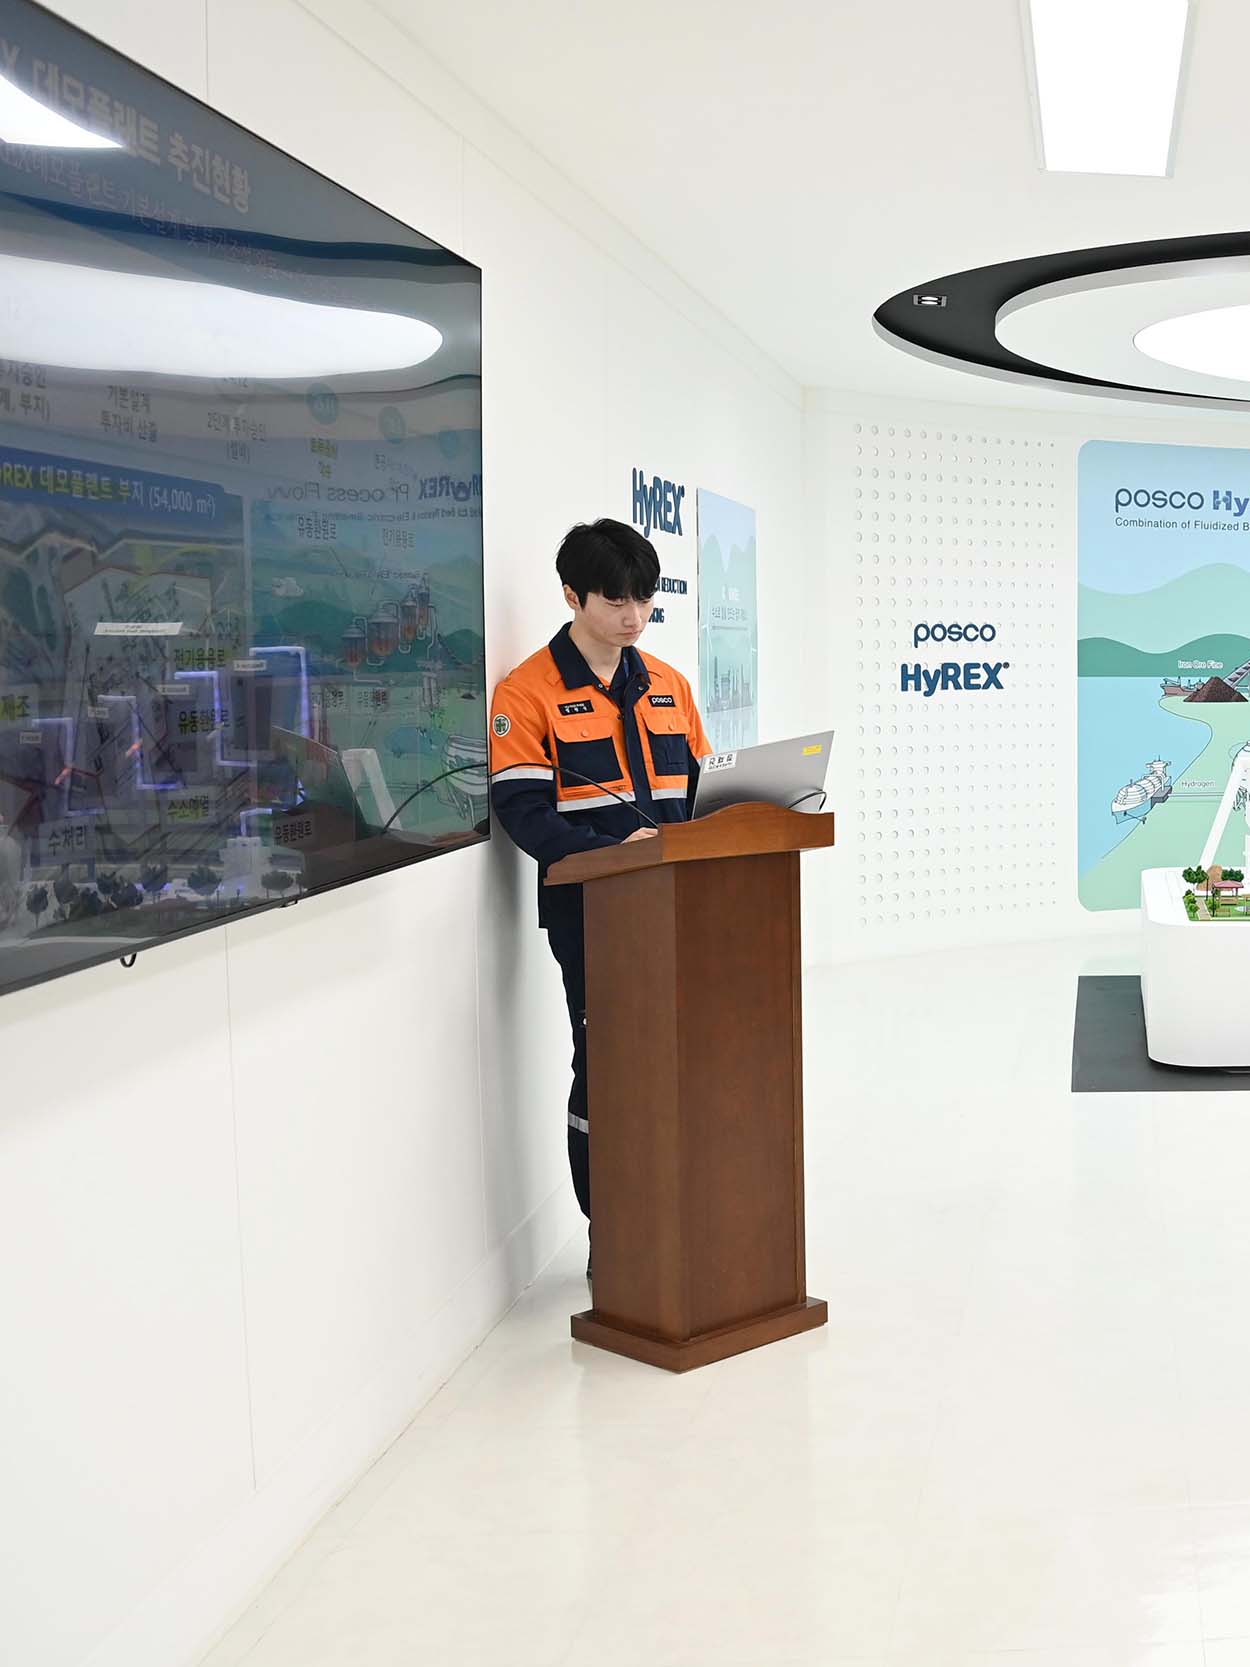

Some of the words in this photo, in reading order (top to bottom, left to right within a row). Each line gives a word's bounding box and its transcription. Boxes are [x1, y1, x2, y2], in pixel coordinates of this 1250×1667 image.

[167, 128, 251, 216] 추진현황
[0, 463, 33, 489] REX
[119, 476, 144, 506] 부지
[148, 486, 193, 514] (54,000
[1115, 487, 1205, 513] posco
[1115, 516, 1178, 529] Combination
[1181, 520, 1191, 530] of
[1194, 520, 1240, 532] Fluidized
[913, 623, 997, 648] posco
[651, 696, 673, 704] posco
[1181, 779, 1215, 789] Hydrogen
